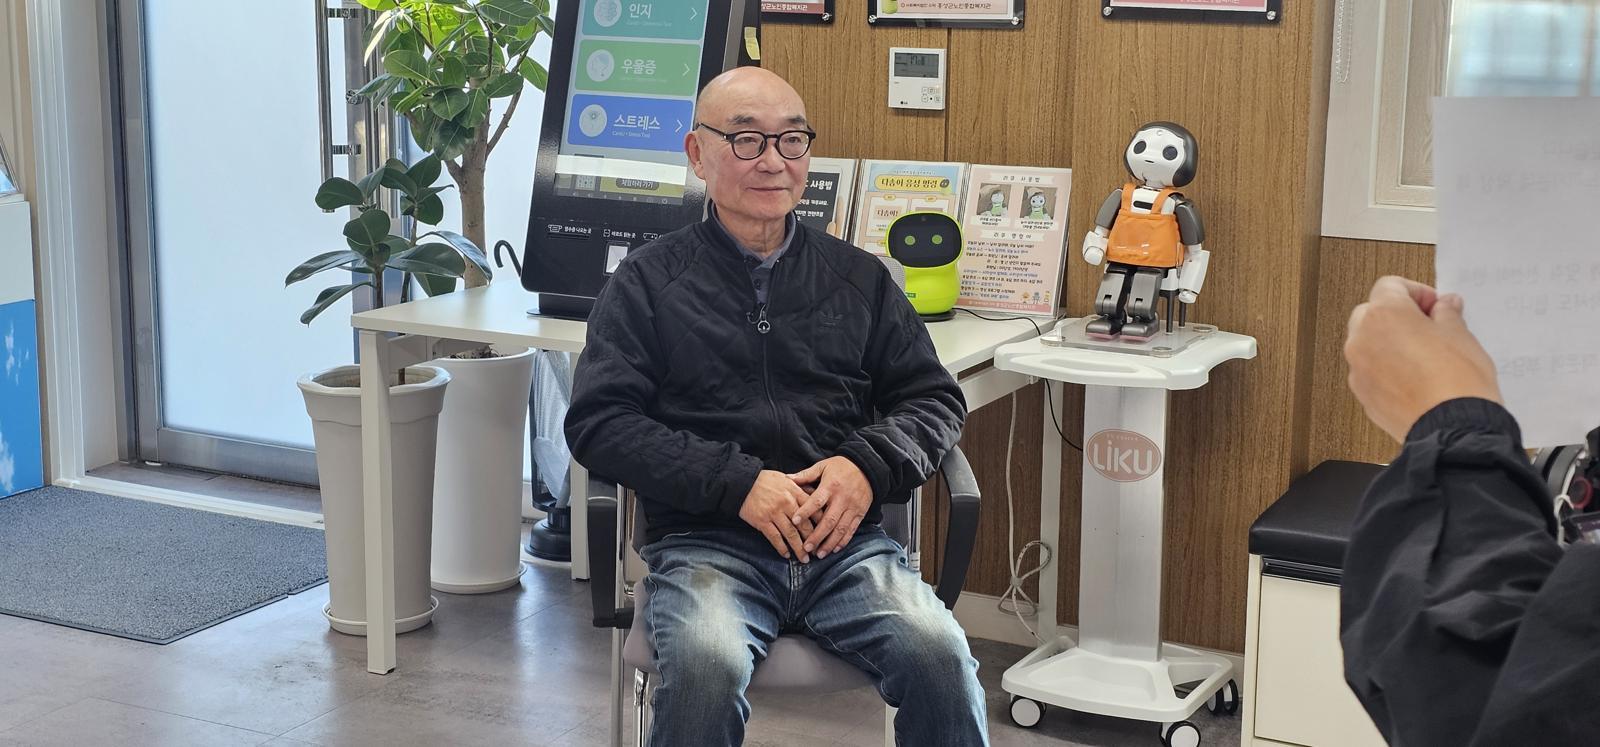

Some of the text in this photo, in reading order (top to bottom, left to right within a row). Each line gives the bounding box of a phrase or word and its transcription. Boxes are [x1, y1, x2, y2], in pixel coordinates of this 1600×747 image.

[629, 3, 652, 19] 인지
[620, 58, 657, 75] 우울증
[613, 113, 661, 131] 스트레스
[810, 179, 833, 190] 사용법
[881, 178, 903, 187] 다솜이
